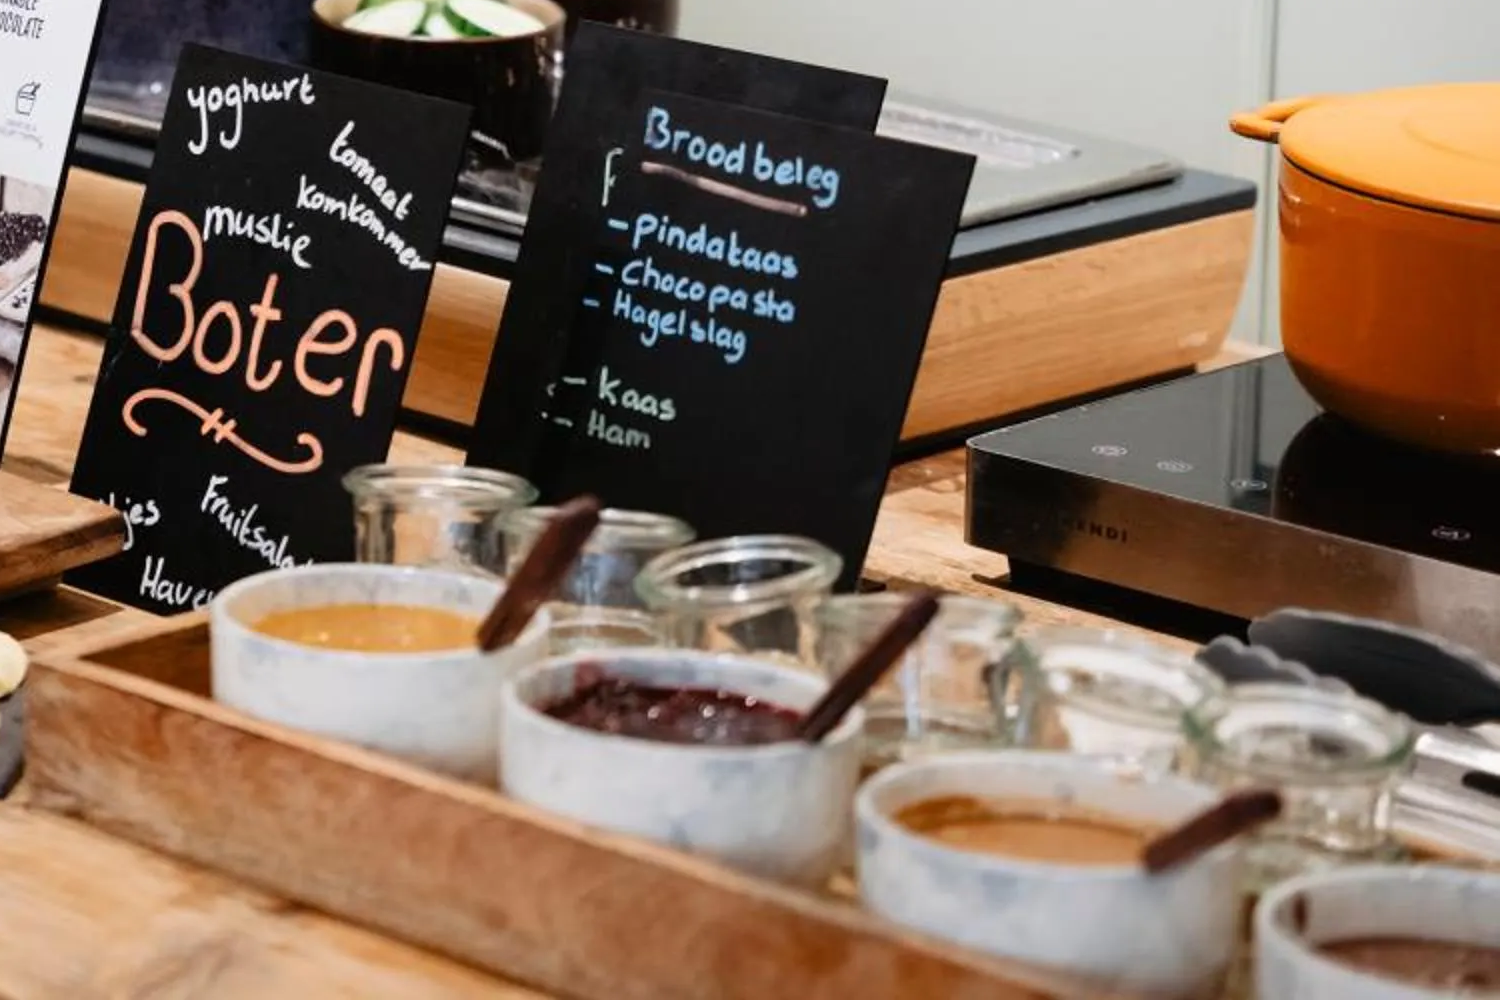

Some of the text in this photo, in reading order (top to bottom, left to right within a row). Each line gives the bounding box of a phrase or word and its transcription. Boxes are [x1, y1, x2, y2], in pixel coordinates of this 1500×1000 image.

[187, 73, 316, 155] yoghurt
[203, 205, 312, 269] muslie
[131, 210, 405, 417] Boter
[587, 408, 651, 449] Ham
